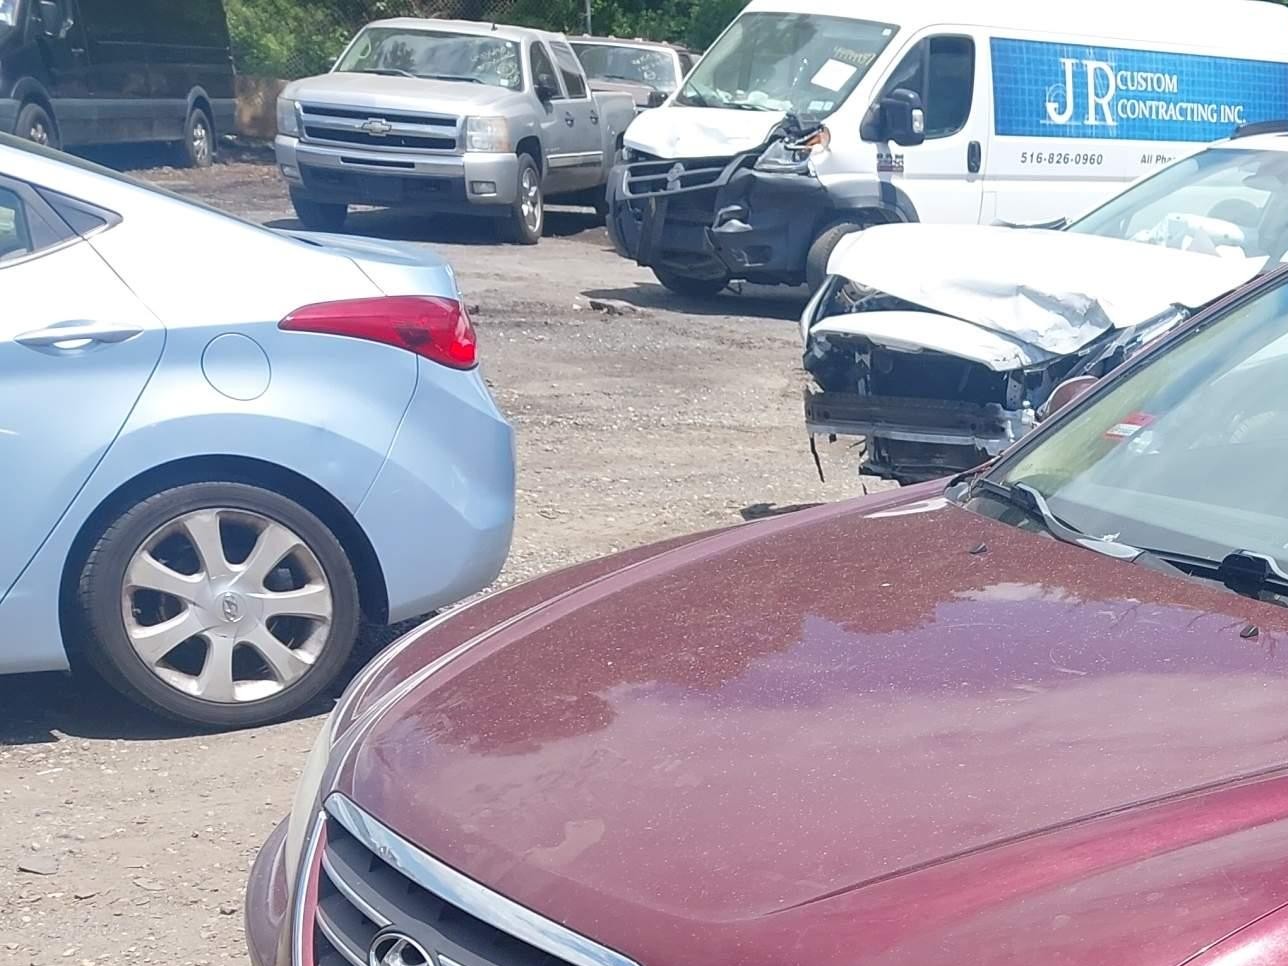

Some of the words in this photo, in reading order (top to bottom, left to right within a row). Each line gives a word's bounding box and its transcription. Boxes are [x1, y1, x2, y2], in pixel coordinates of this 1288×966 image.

[1044, 57, 1118, 126] JR
[1117, 70, 1178, 93] CUSTOM
[1117, 99, 1218, 123] CONTRACTING
[1220, 106, 1247, 124] INC.
[1020, 152, 1104, 166] 516-826-0960
[1140, 153, 1153, 164] All
